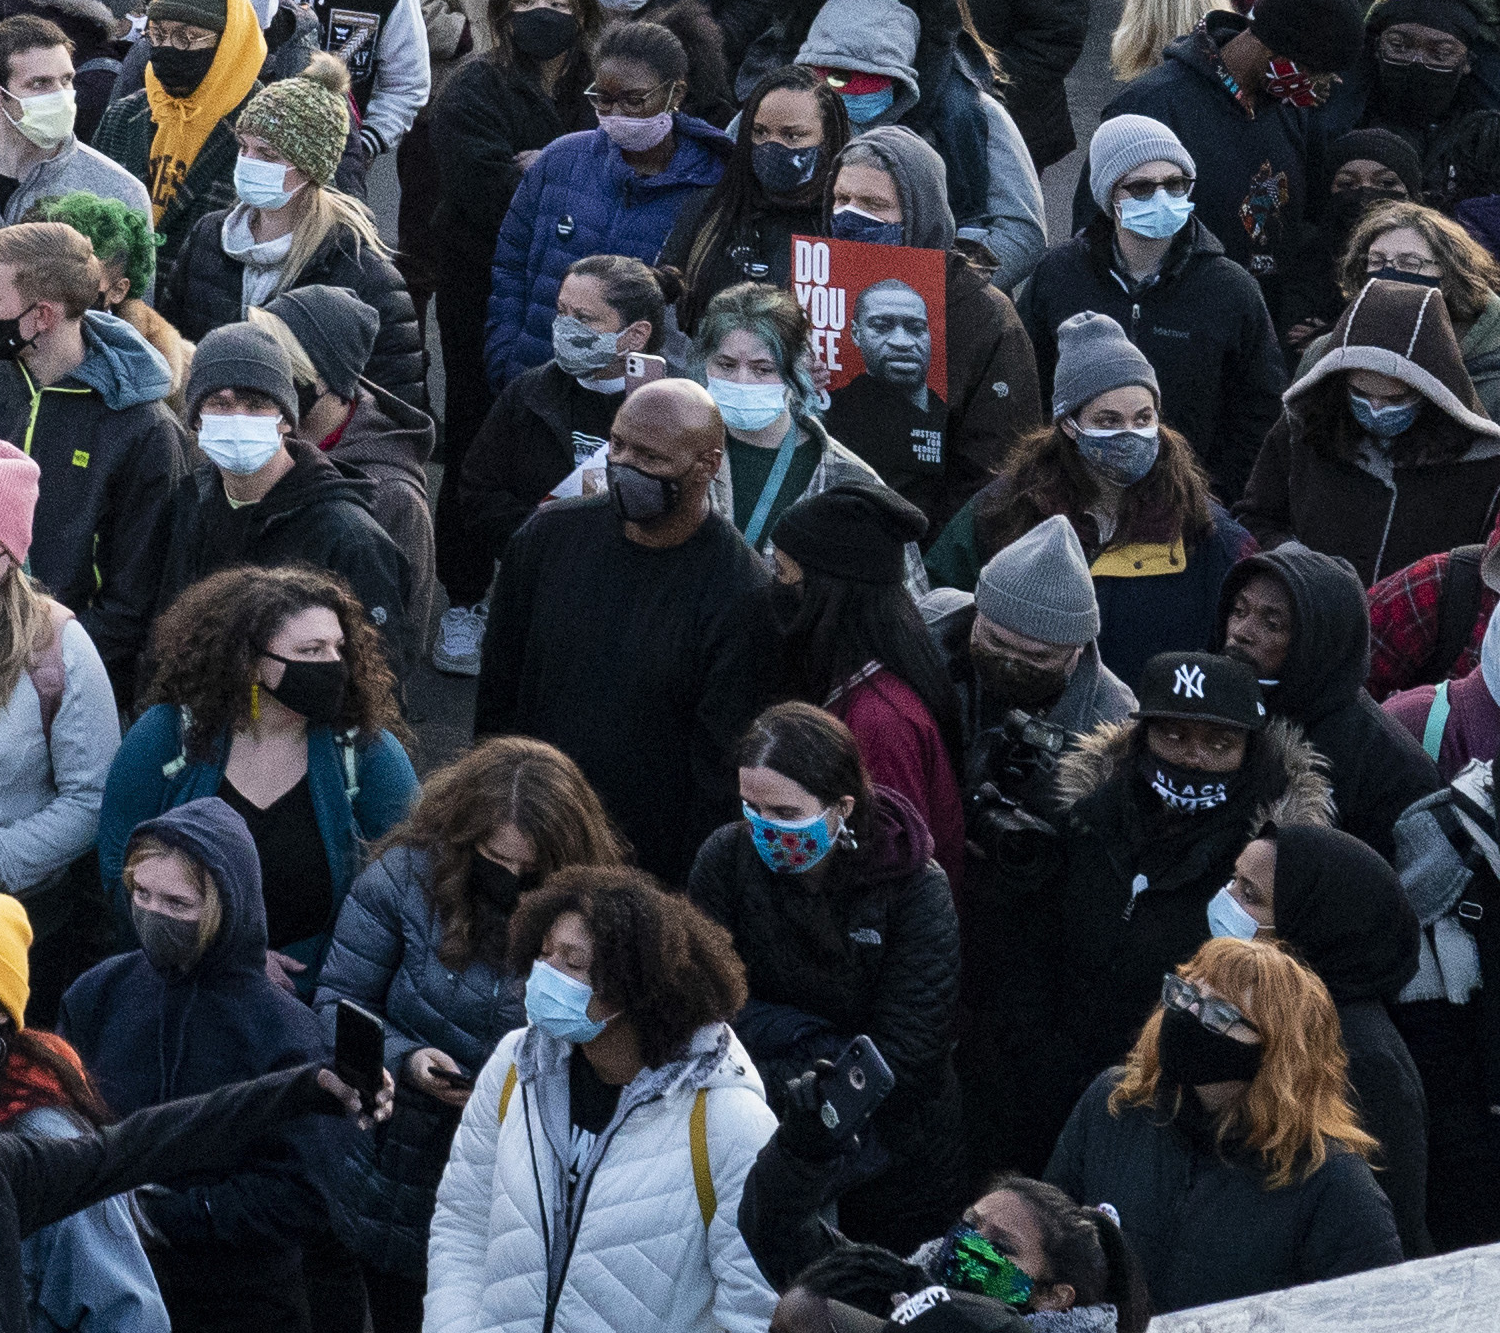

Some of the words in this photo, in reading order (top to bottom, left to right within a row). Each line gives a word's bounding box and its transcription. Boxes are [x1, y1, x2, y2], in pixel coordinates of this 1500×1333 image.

[794, 239, 830, 287] DO
[793, 284, 846, 332] YOU
[910, 428, 942, 439] JUSTICE
[925, 437, 942, 448] FOR
[911, 444, 941, 456] GEORGE
[917, 453, 942, 464] FLOYD
[1171, 663, 1206, 699] NY
[1154, 770, 1228, 799] BLACK
